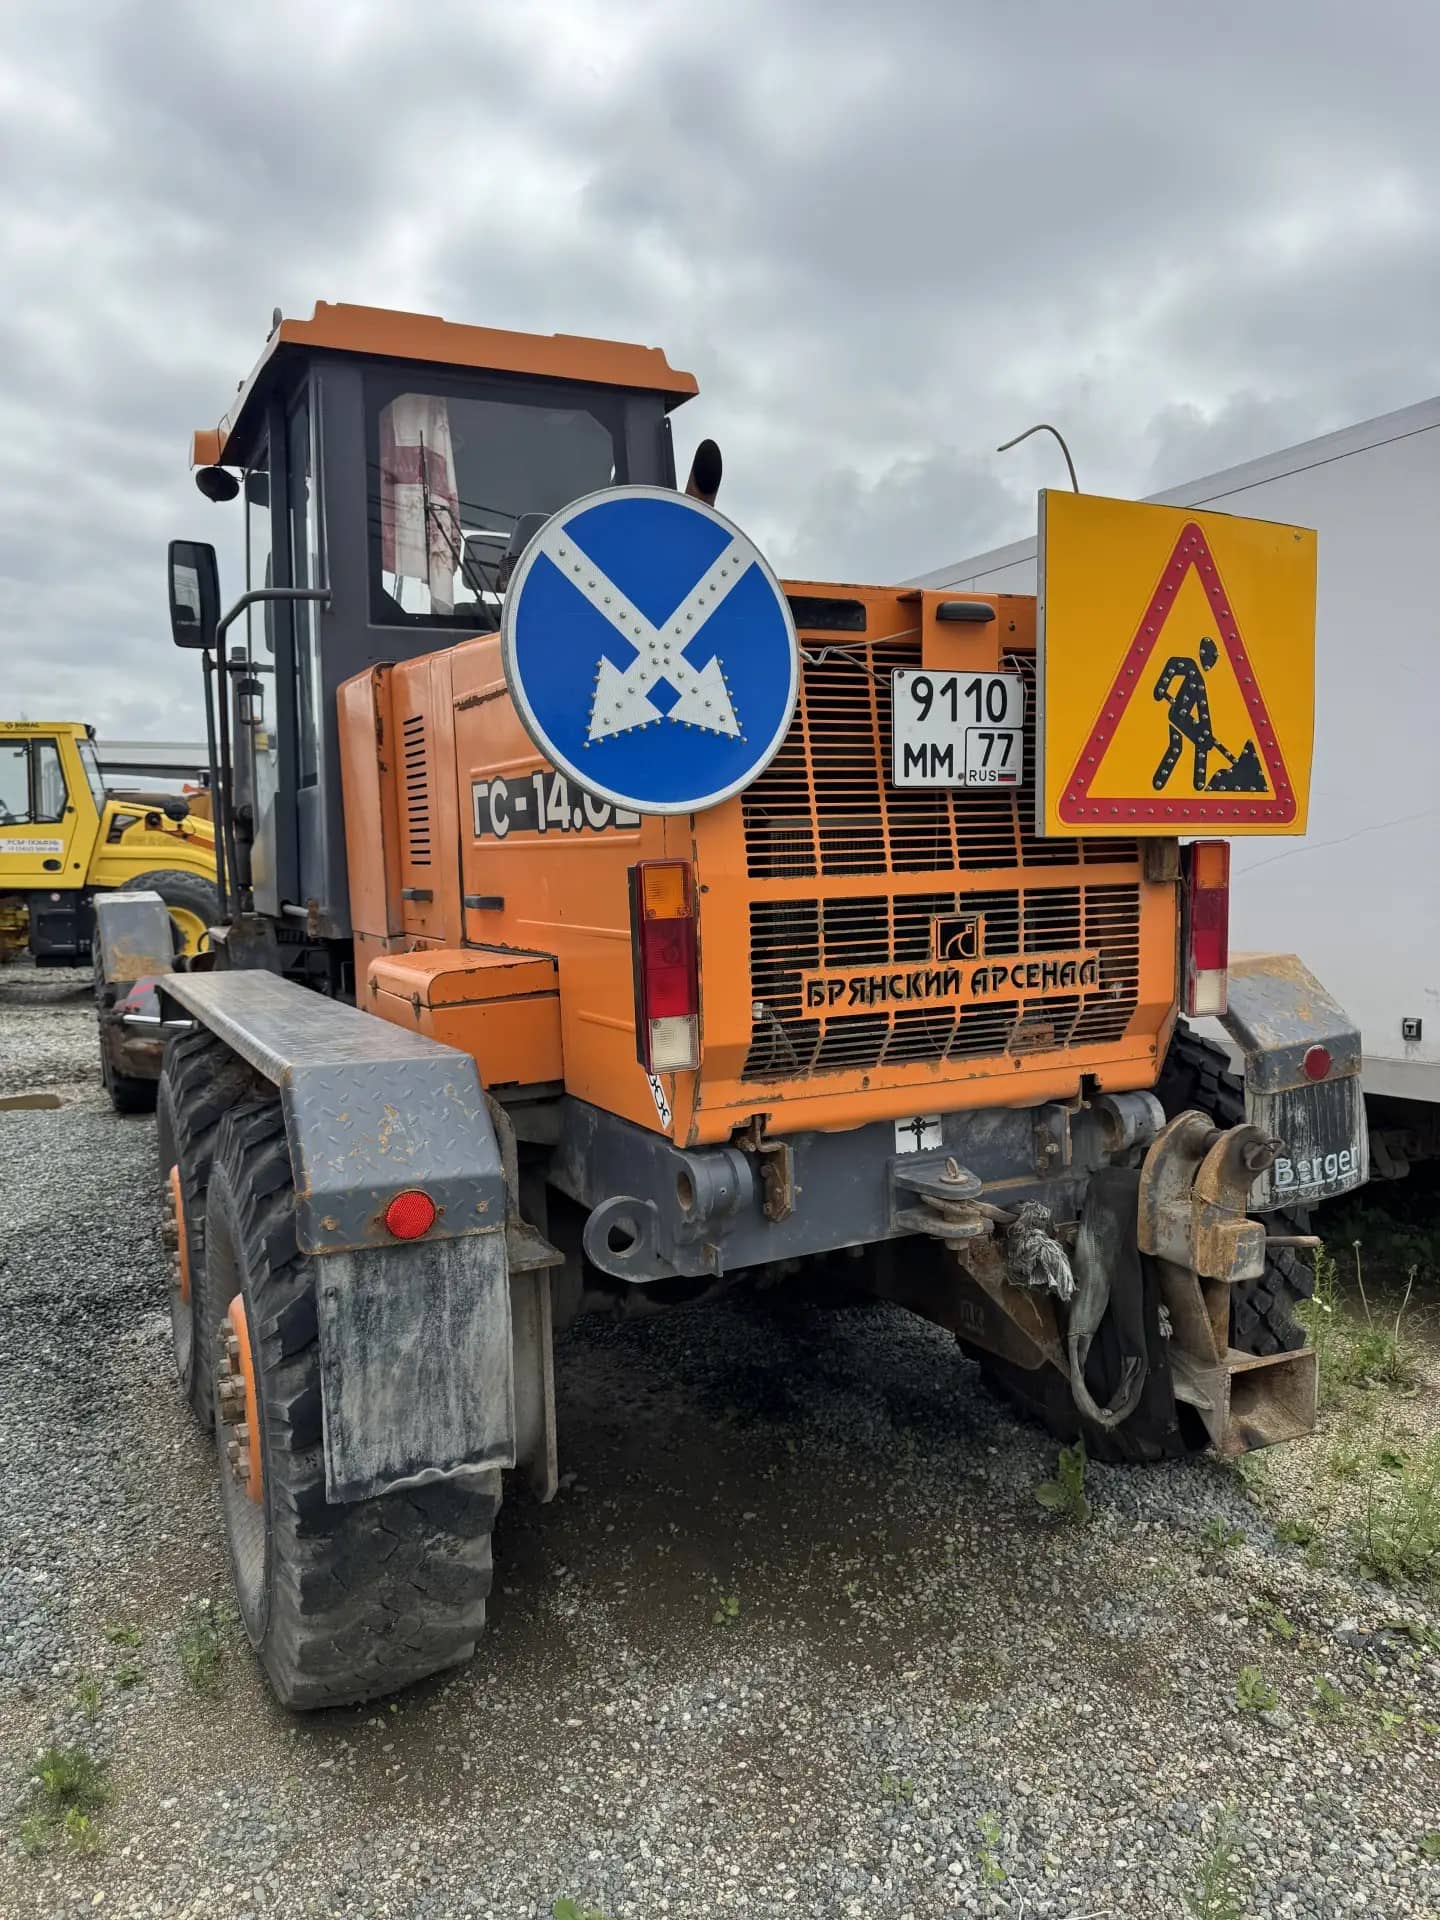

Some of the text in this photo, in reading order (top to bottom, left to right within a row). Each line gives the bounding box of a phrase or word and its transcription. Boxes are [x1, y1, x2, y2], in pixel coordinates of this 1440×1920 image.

[911, 676, 1007, 723] 9110
[904, 743, 954, 778] ММ
[978, 733, 1013, 767] 77
[969, 770, 996, 782] RUS
[472, 770, 640, 836] ГС-14.0
[807, 957, 1098, 1008] БРЯНСКИЙ АРСЕНАЛ
[1275, 1145, 1358, 1186] Berger
